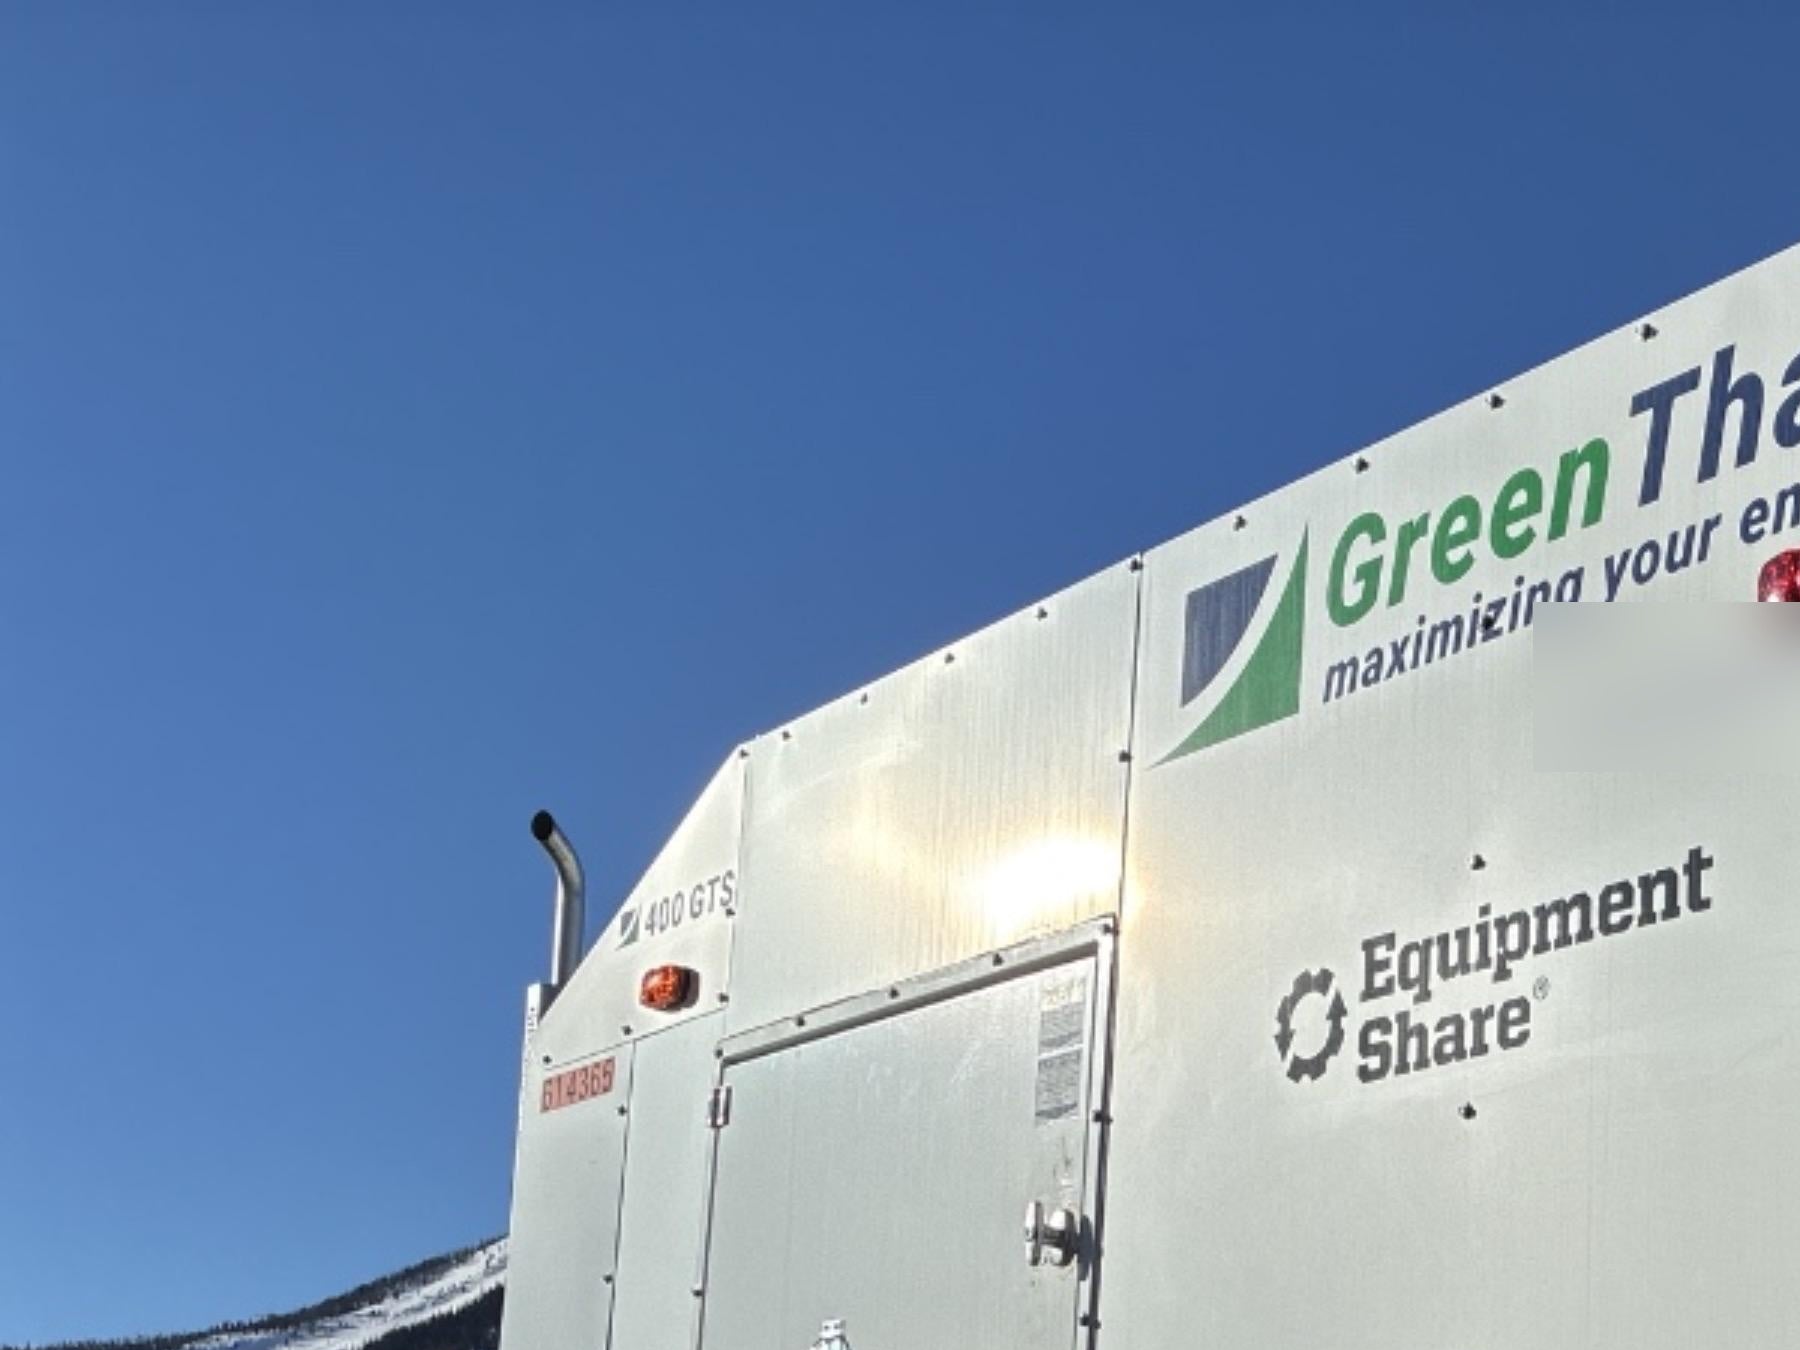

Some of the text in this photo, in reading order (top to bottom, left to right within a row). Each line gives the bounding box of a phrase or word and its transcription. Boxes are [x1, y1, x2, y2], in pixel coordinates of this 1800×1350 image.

[1603, 511, 1723, 602] your
[644, 869, 736, 937] 400 GTS
[1360, 845, 1714, 1003] Equipment
